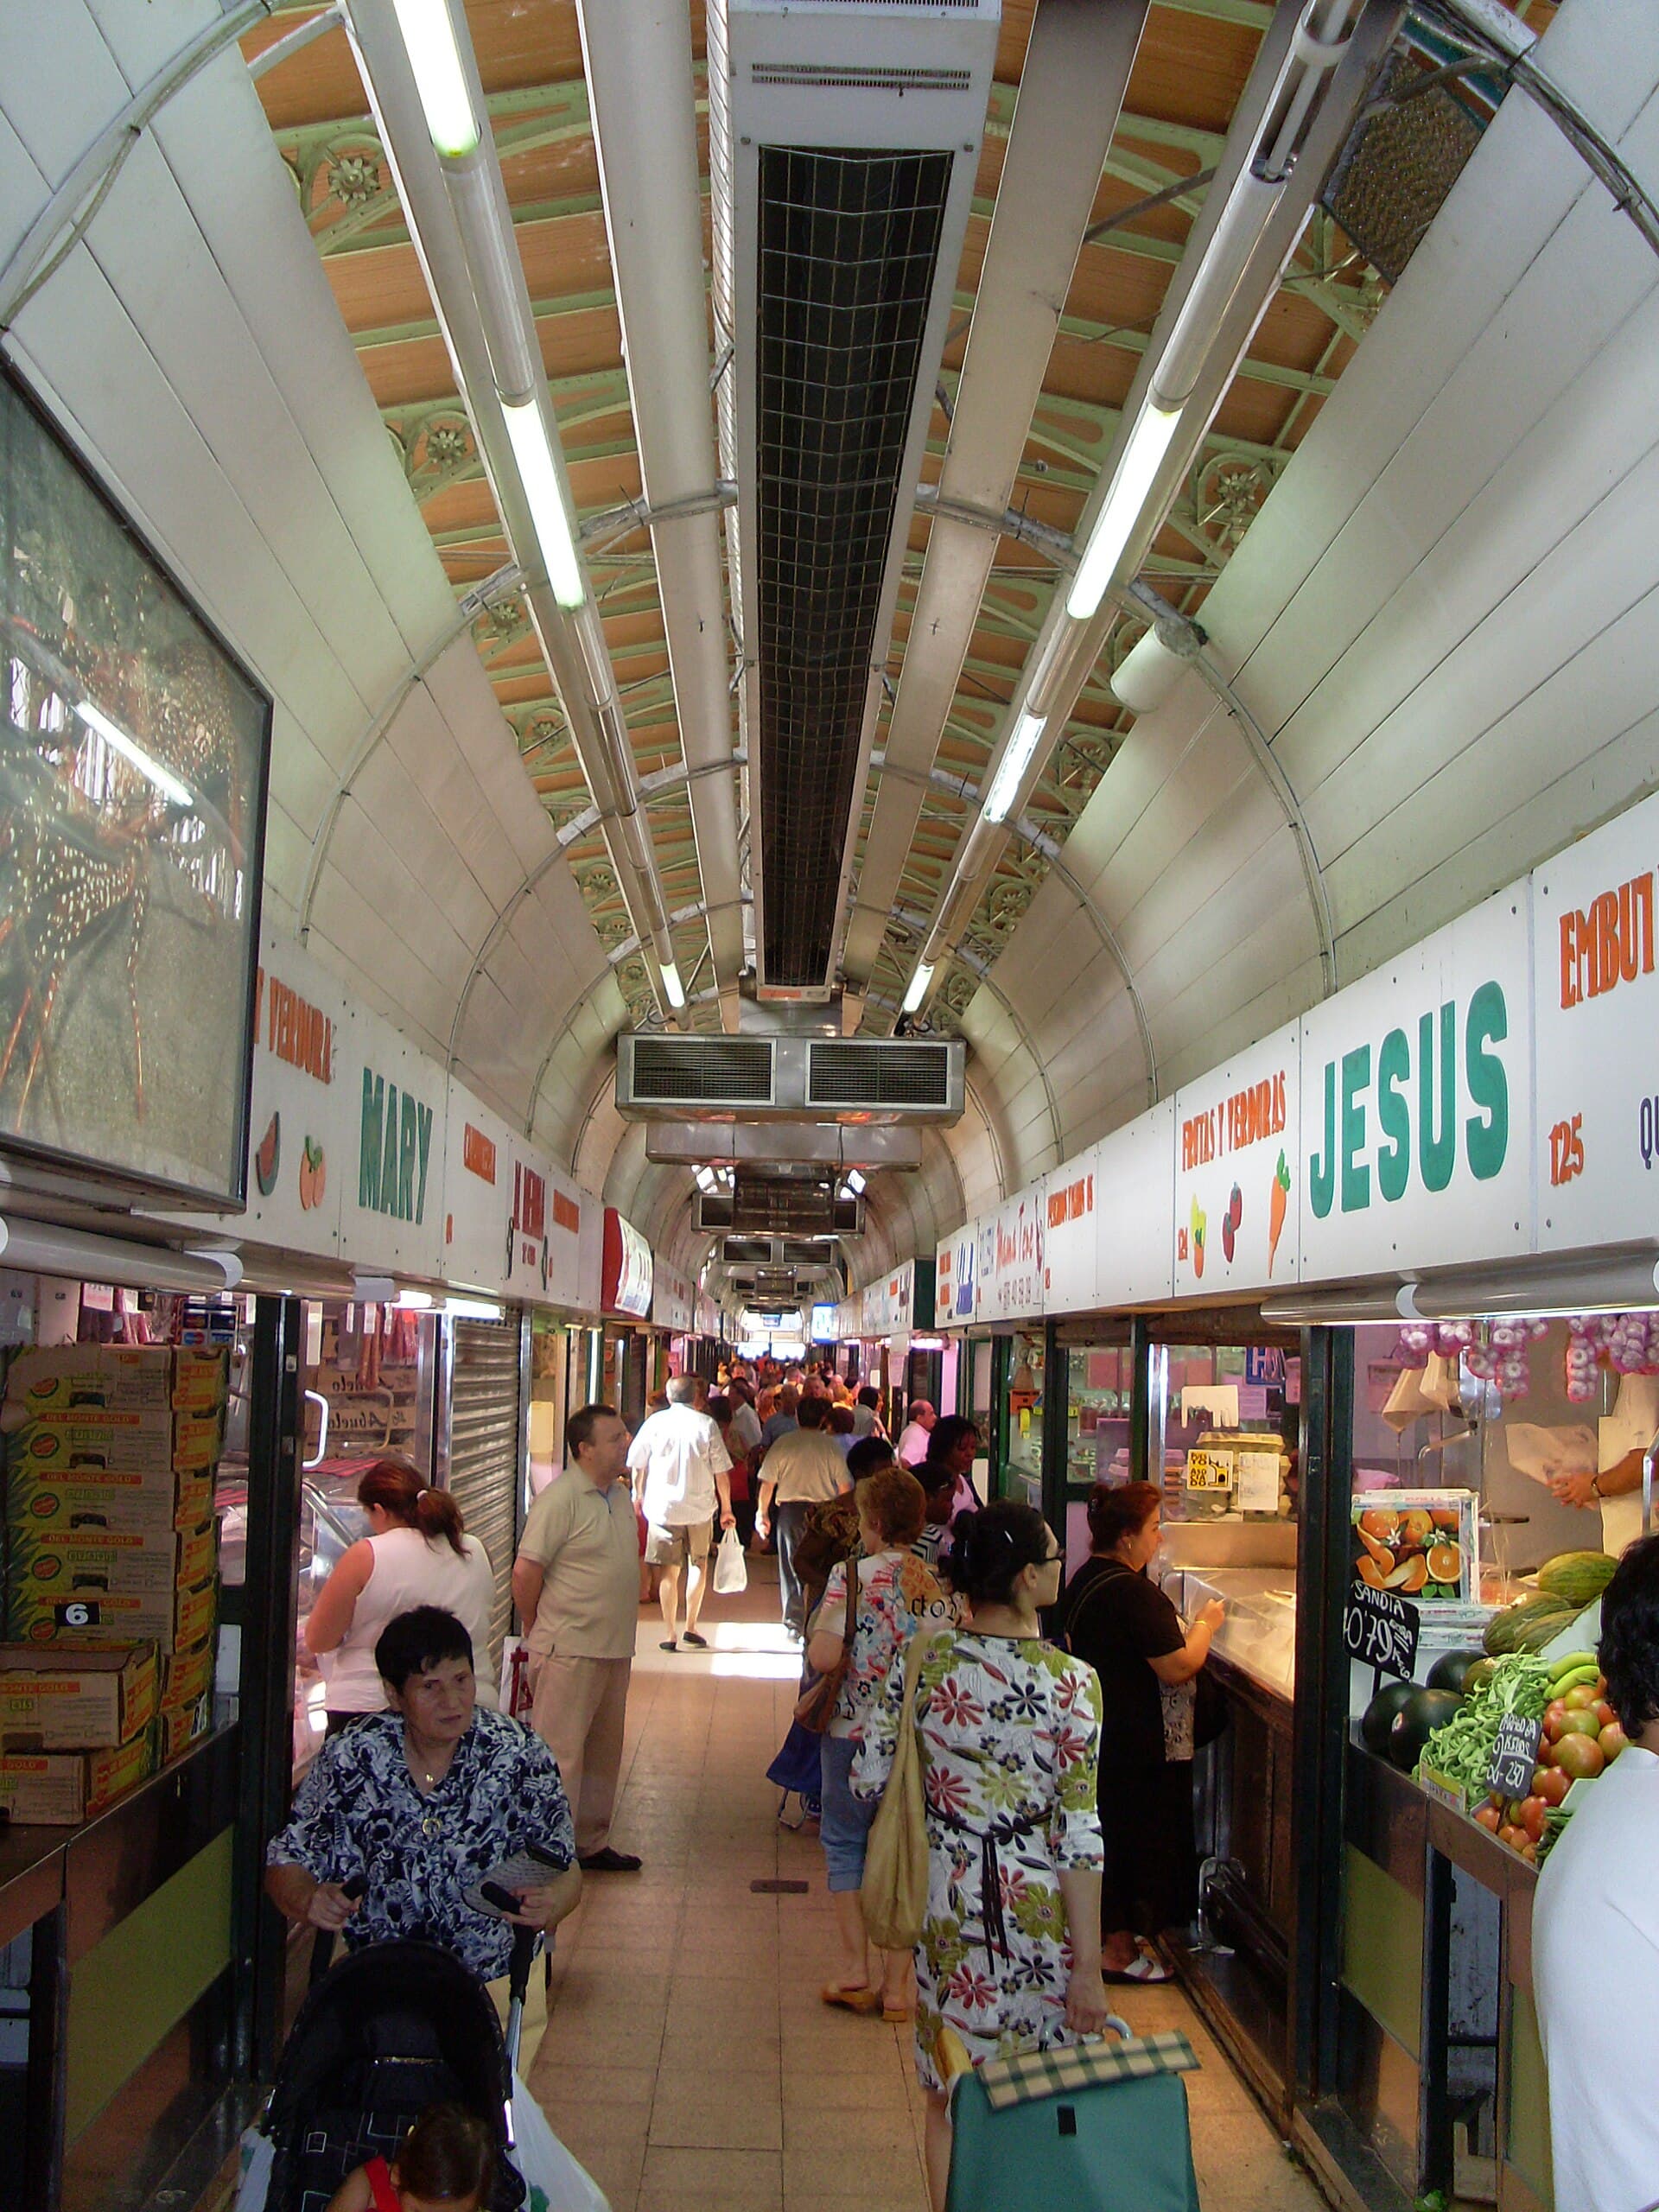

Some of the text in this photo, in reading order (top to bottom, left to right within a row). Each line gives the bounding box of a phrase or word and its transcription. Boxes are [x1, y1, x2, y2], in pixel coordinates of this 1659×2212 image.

[1181, 1069, 1287, 1173] FRUTAS Y VERDURAS
[1310, 980, 1508, 1219] JESUS
[358, 1065, 433, 1225] MARY
[1548, 1111, 1585, 1187] 125
[66, 1603, 89, 1624] 6
[1354, 1581, 1405, 1619] SANDIA
